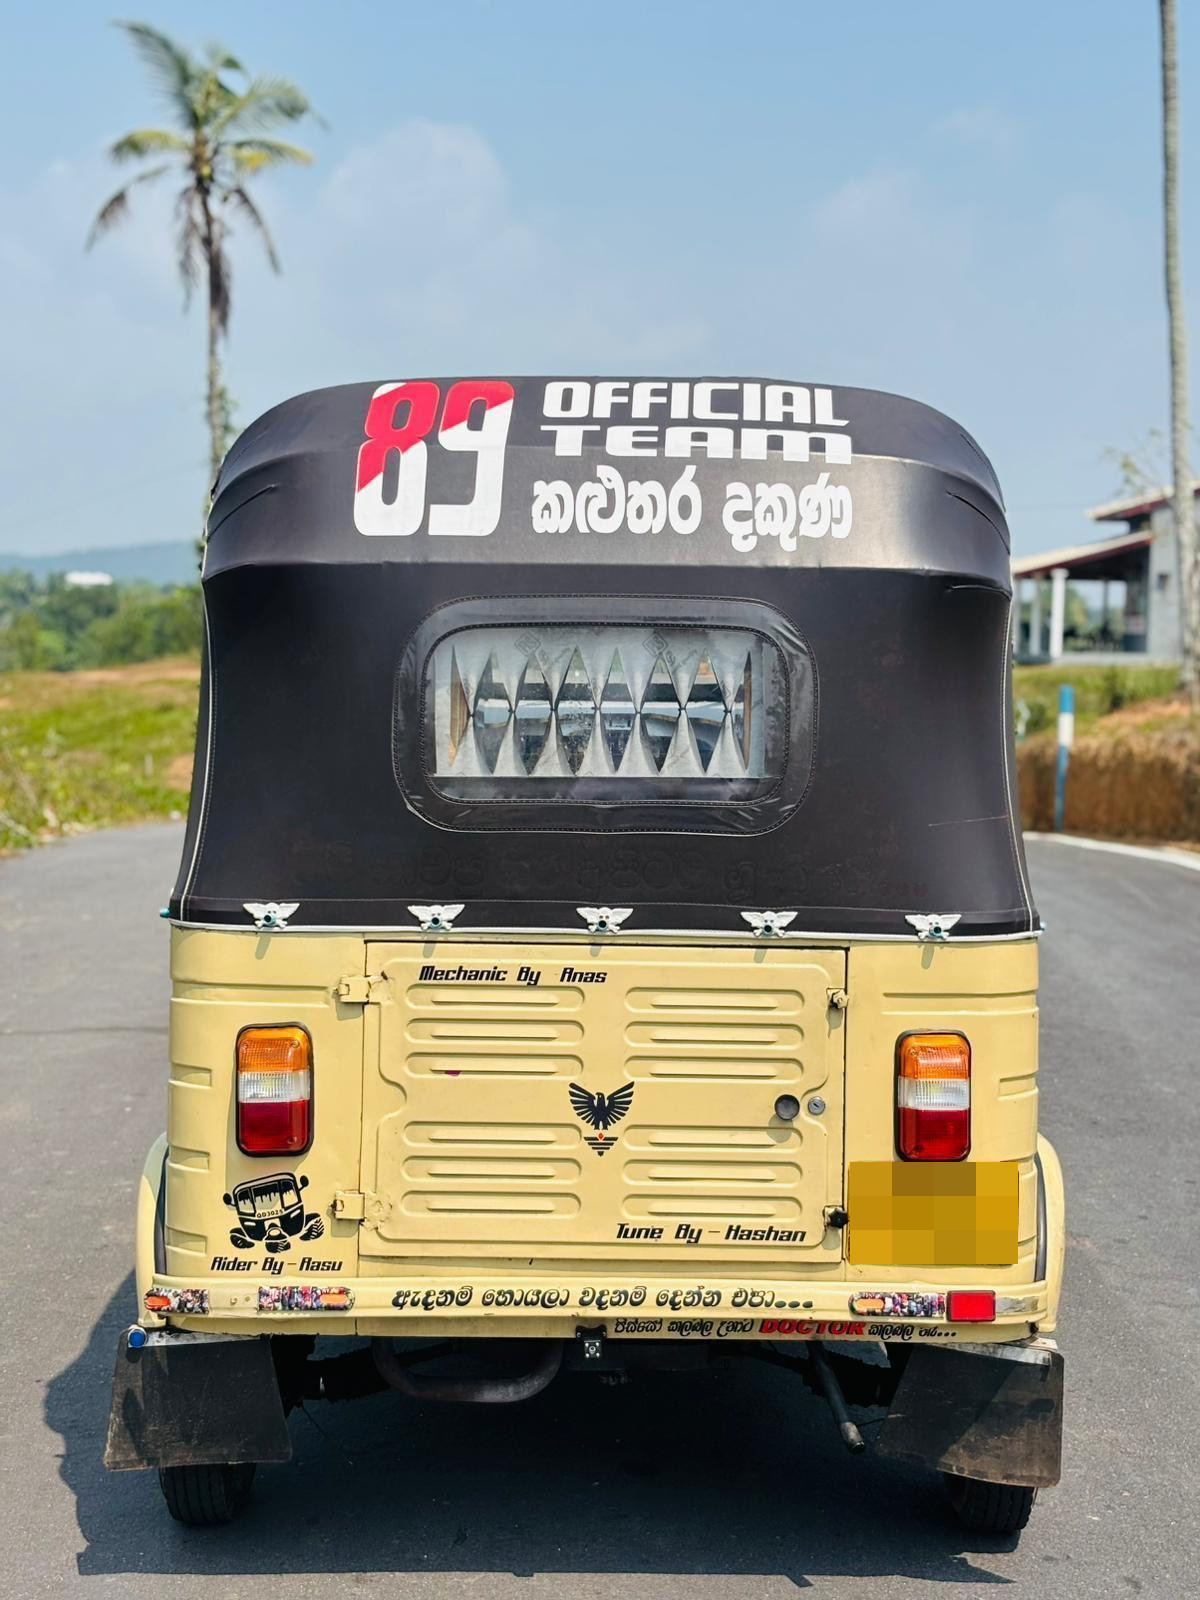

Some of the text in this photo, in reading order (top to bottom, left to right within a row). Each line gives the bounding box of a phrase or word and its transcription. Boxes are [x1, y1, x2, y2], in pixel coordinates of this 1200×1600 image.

[542, 381, 850, 427] OFFICIAL
[353, 380, 515, 537] 89
[540, 425, 853, 465] TEAM
[531, 464, 853, 553] කළුතර දකුණ
[418, 965, 608, 986] Mechanic By Anas
[616, 1223, 664, 1240] Tune
[674, 1223, 703, 1244] By
[725, 1224, 807, 1242] Hashan
[210, 1256, 258, 1272] Rider
[261, 1256, 284, 1275] By
[481, 1288, 570, 1309] හොයලා
[578, 1286, 647, 1311] වදනම්
[655, 1285, 722, 1312] දෙන්න
[758, 1319, 864, 1338] DOCTOR
